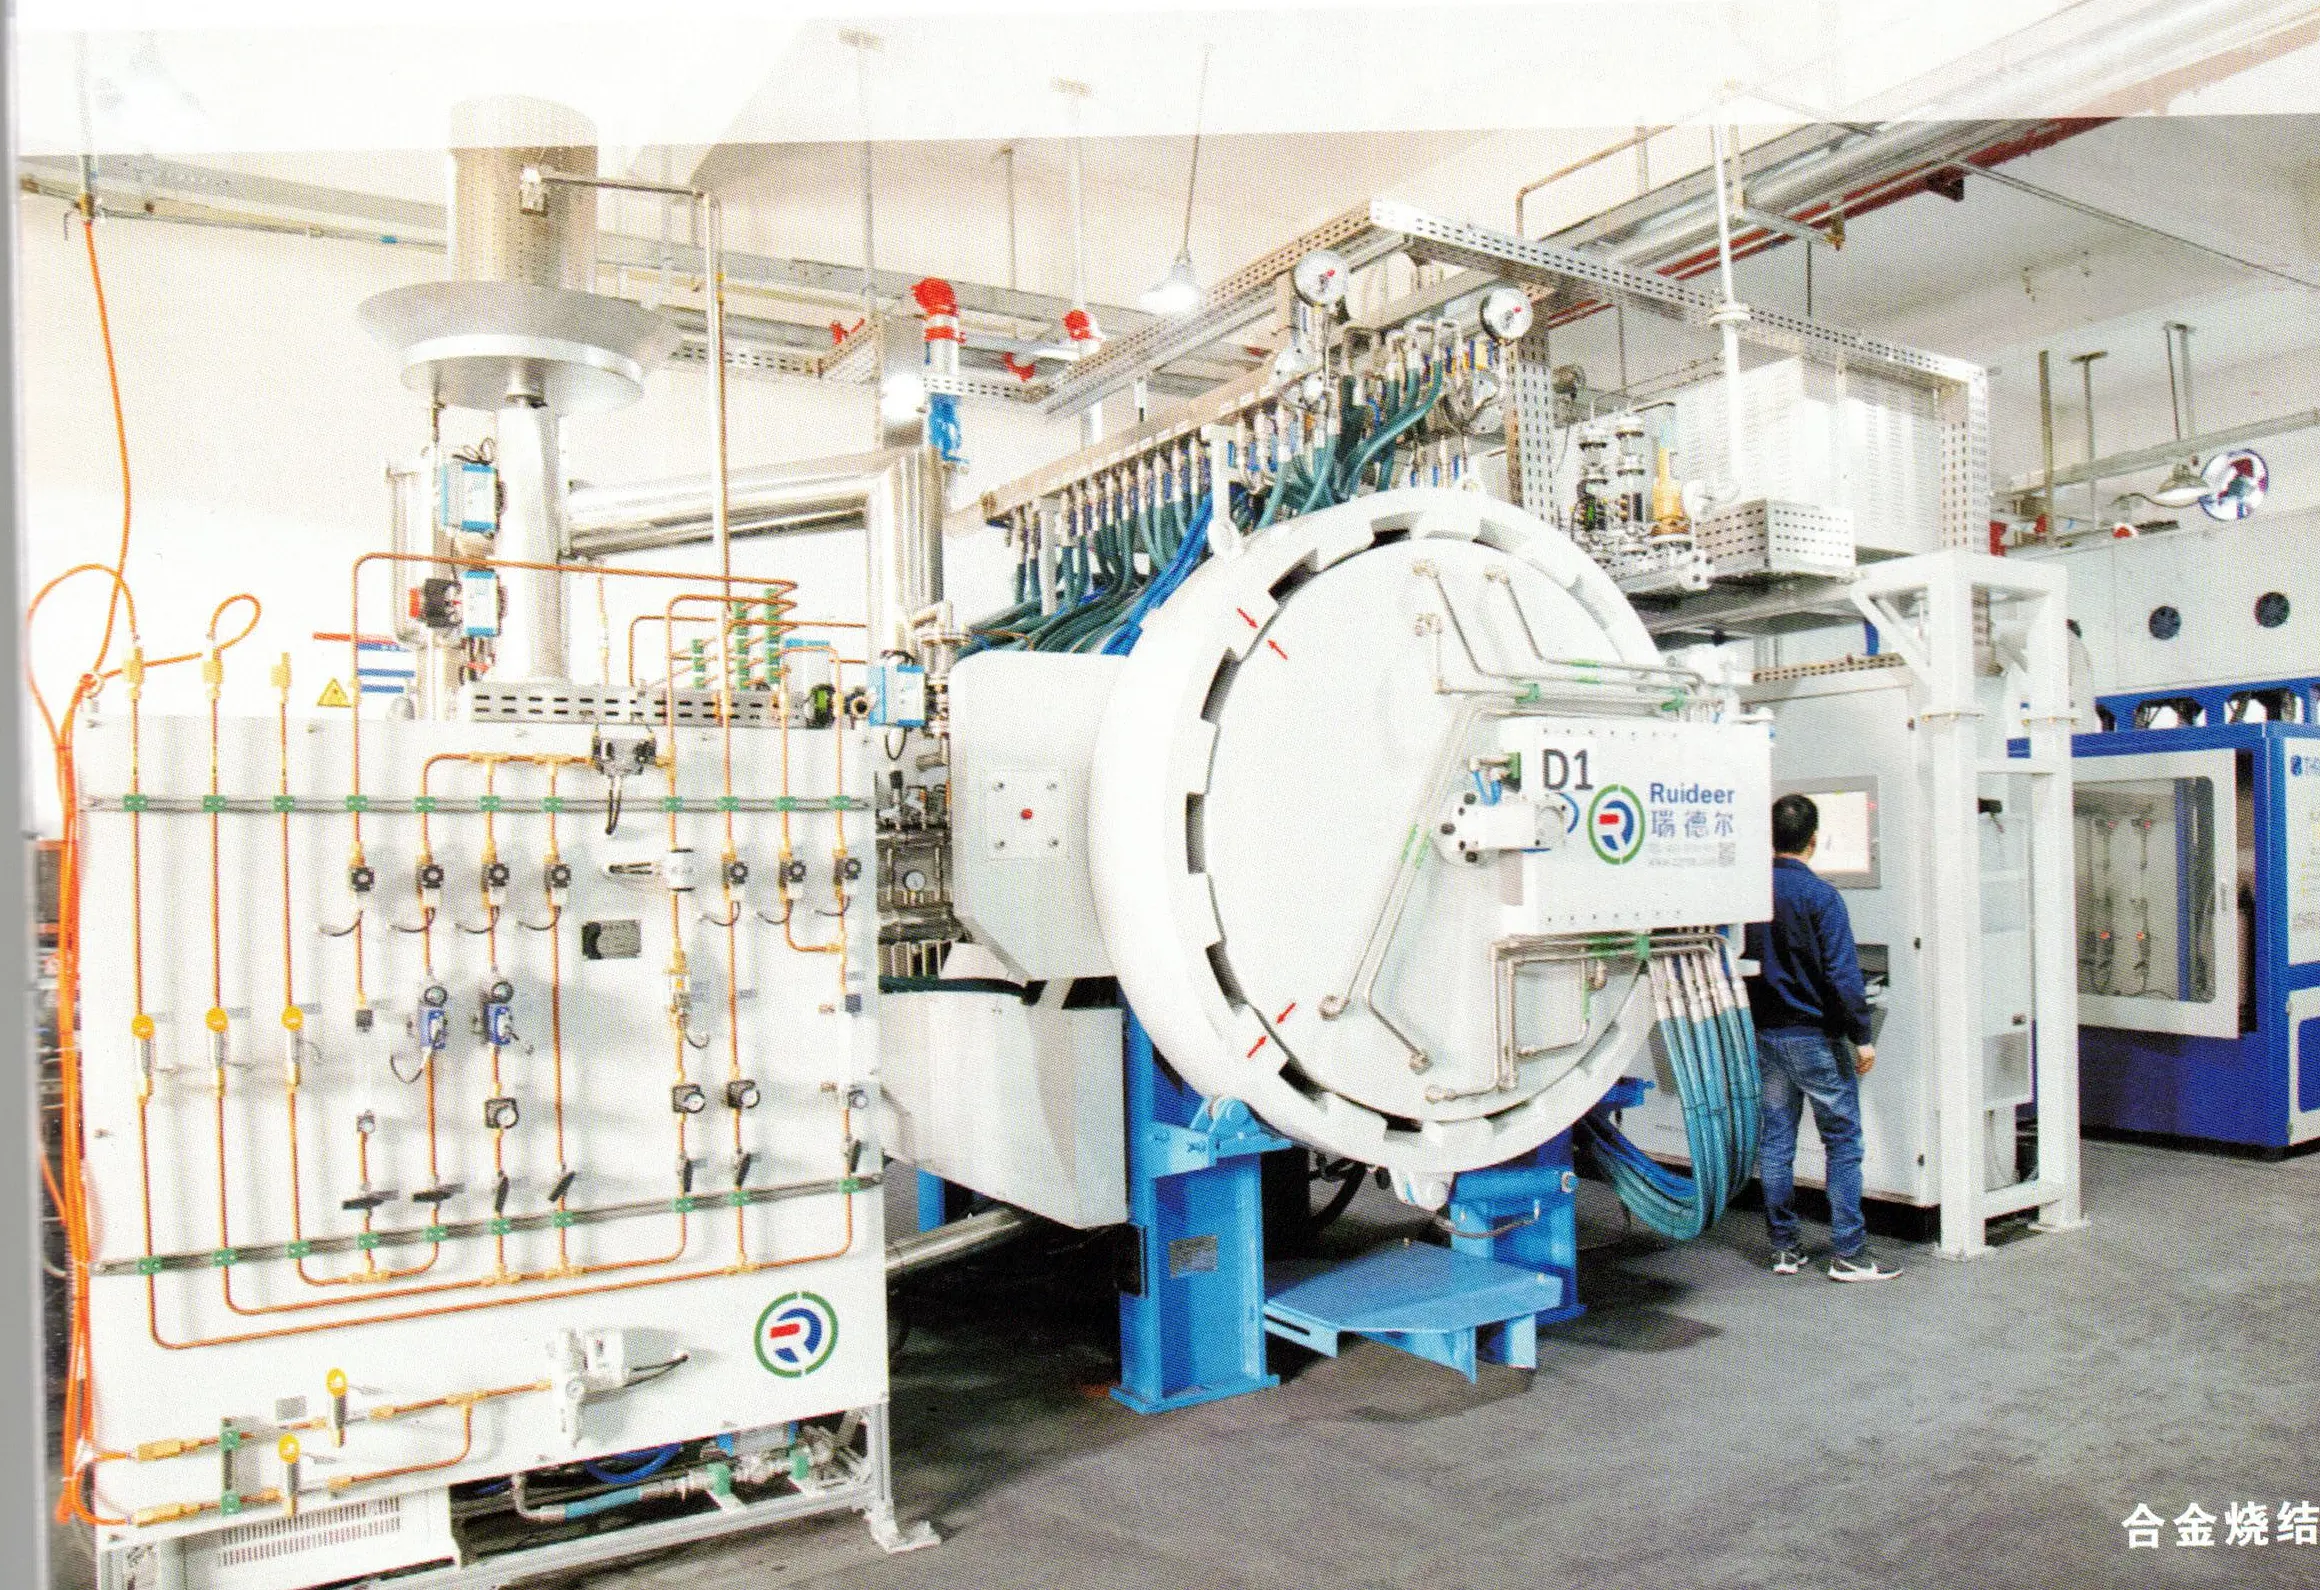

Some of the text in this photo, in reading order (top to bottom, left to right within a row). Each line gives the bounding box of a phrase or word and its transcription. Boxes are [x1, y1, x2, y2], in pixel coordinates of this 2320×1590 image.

[1542, 749, 1594, 790] D1
[1650, 782, 1735, 804] Ruideer
[1651, 809, 1734, 838] 瑞德尔
